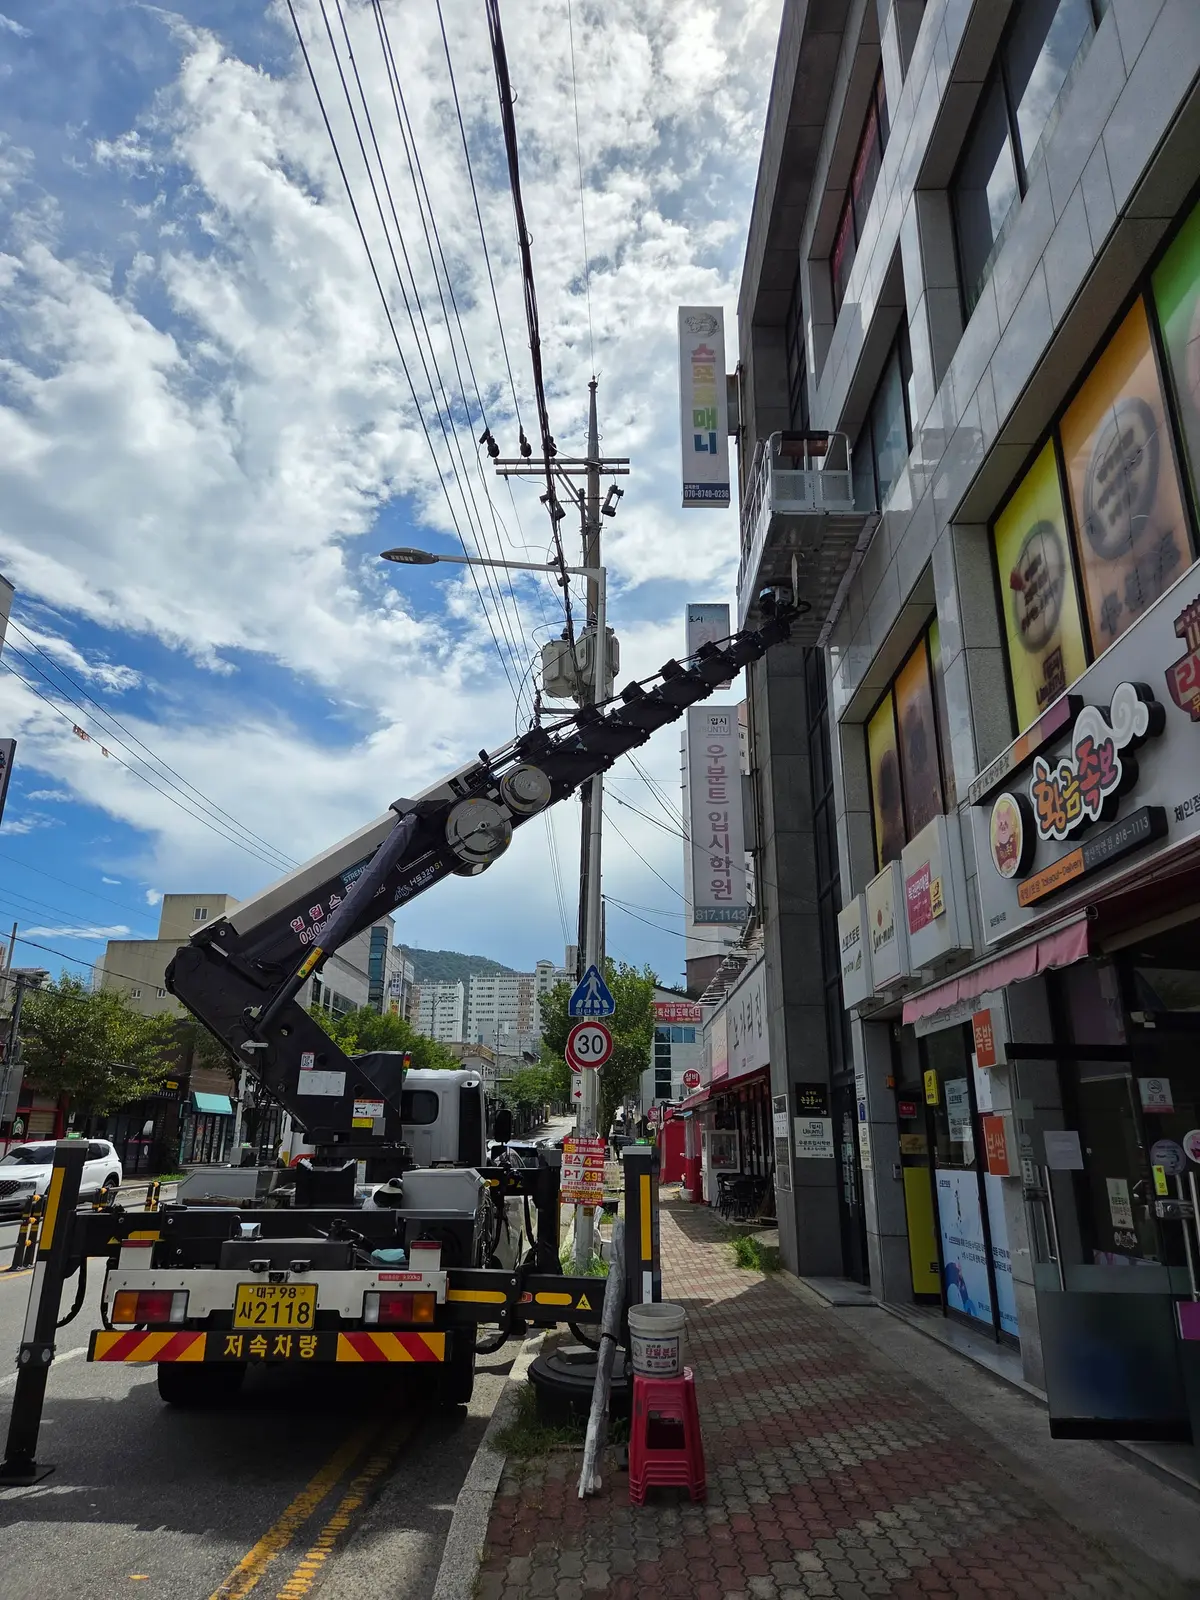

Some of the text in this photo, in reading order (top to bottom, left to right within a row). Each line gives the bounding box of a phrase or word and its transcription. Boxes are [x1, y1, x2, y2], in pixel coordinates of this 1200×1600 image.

[710, 717, 727, 725] 입시
[1034, 739, 1116, 829] 황금족보
[695, 909, 746, 921] 817.1143
[576, 1008, 609, 1016] 횡단보도
[577, 1034, 604, 1055] 30
[975, 1023, 993, 1053] 족발
[989, 1135, 1005, 1160] 보쌈
[565, 1154, 581, 1165] 헬스
[256, 1286, 297, 1299] 대구 98
[224, 1334, 318, 1359] 저속차량
